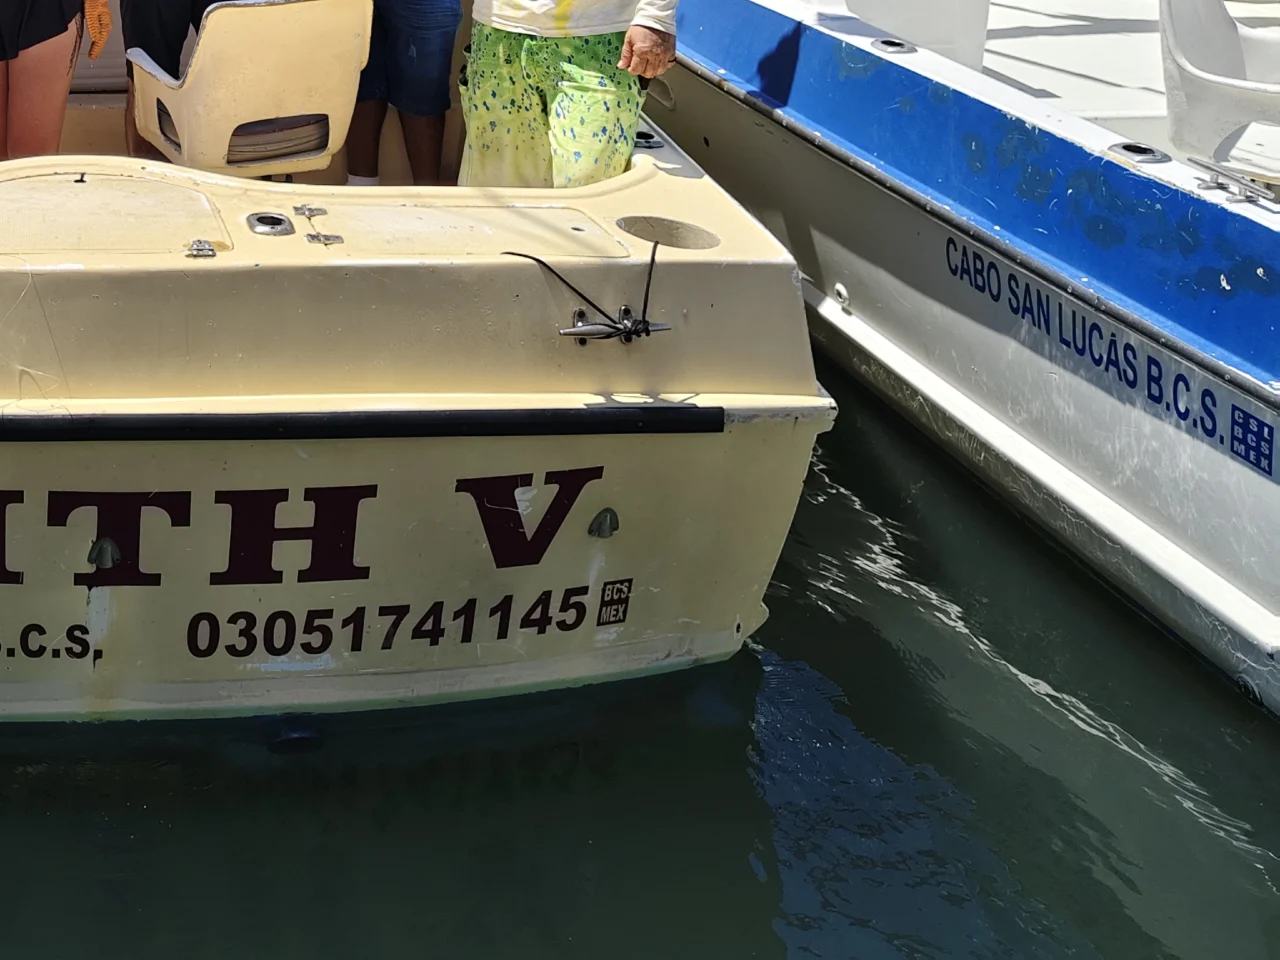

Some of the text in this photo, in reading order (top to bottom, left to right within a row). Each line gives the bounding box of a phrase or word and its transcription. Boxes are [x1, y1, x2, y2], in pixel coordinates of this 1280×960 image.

[945, 236, 1002, 303] CABO
[1007, 273, 1051, 337] SAN
[1146, 355, 1224, 446] B.C.S.
[454, 465, 605, 570] V
[186, 585, 590, 659] 03051741145
[600, 603, 626, 623] MEX
[603, 581, 629, 602] BCS
